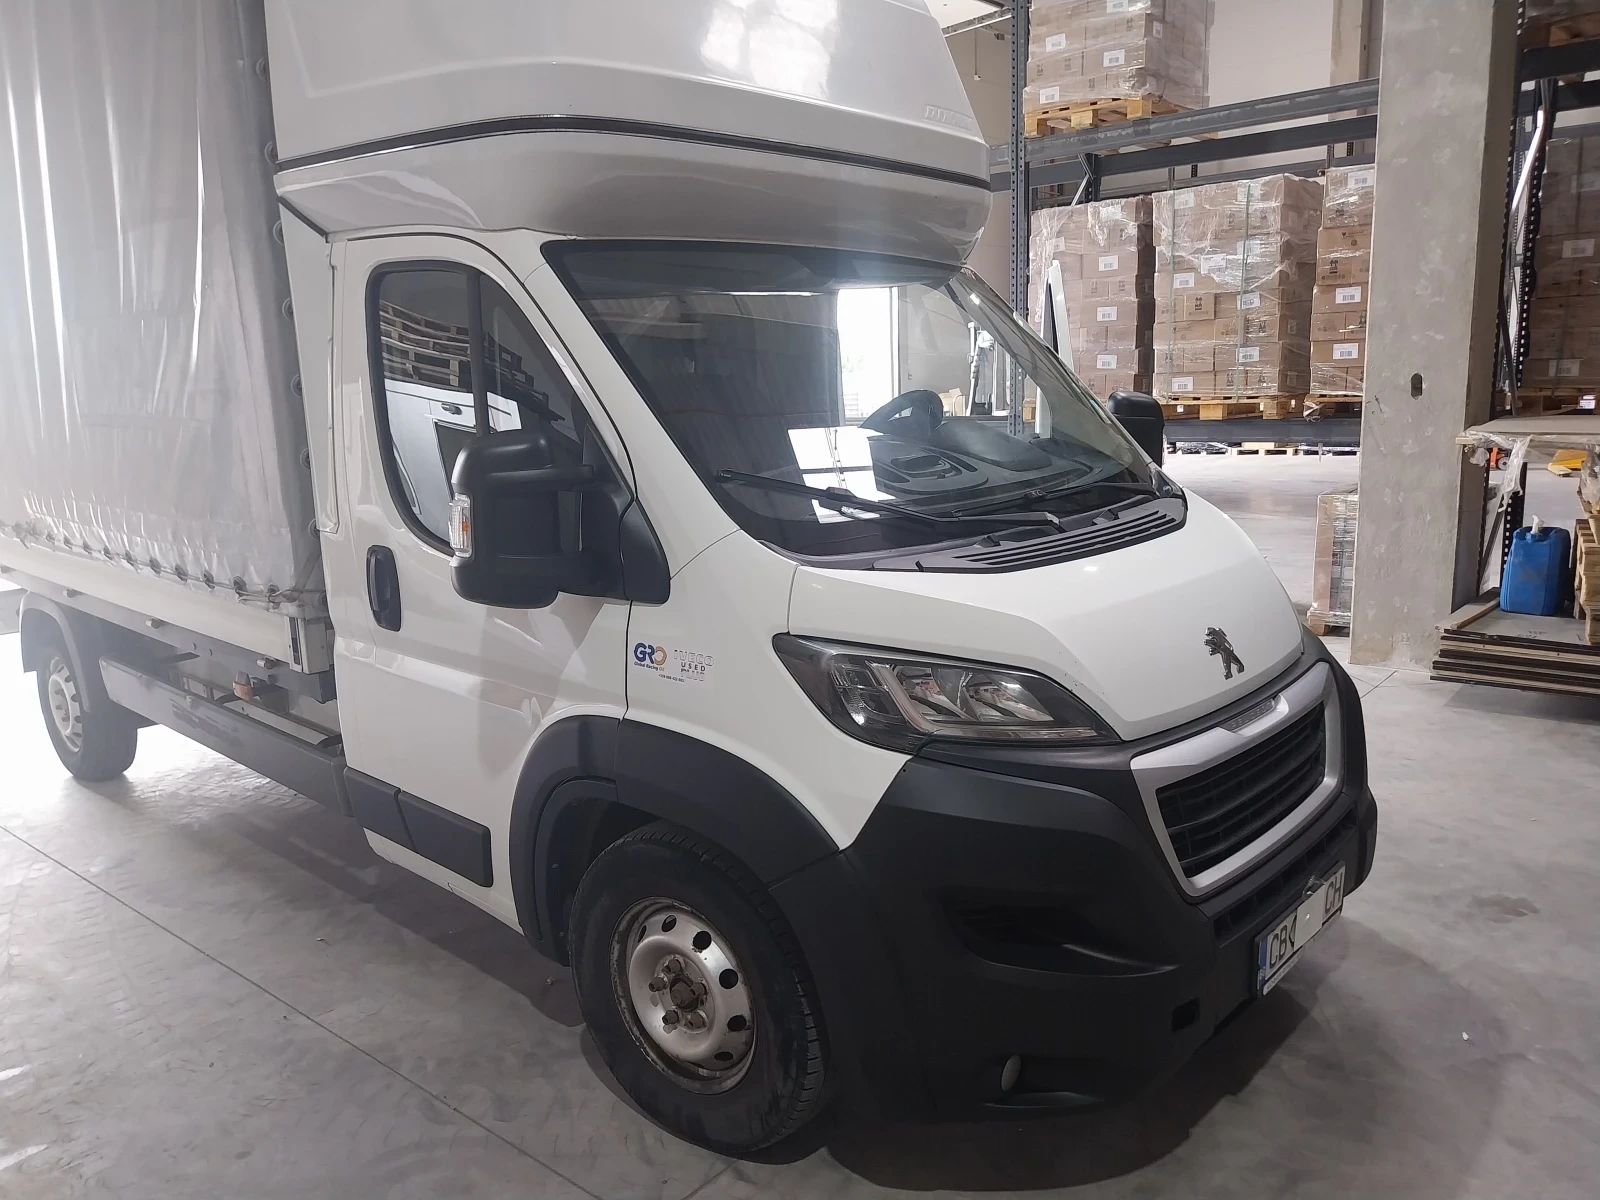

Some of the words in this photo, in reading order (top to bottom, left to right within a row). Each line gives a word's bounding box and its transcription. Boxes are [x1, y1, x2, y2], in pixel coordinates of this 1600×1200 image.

[634, 642, 667, 665] GRO
[674, 649, 714, 666] IVECO
[681, 661, 706, 672] USED
